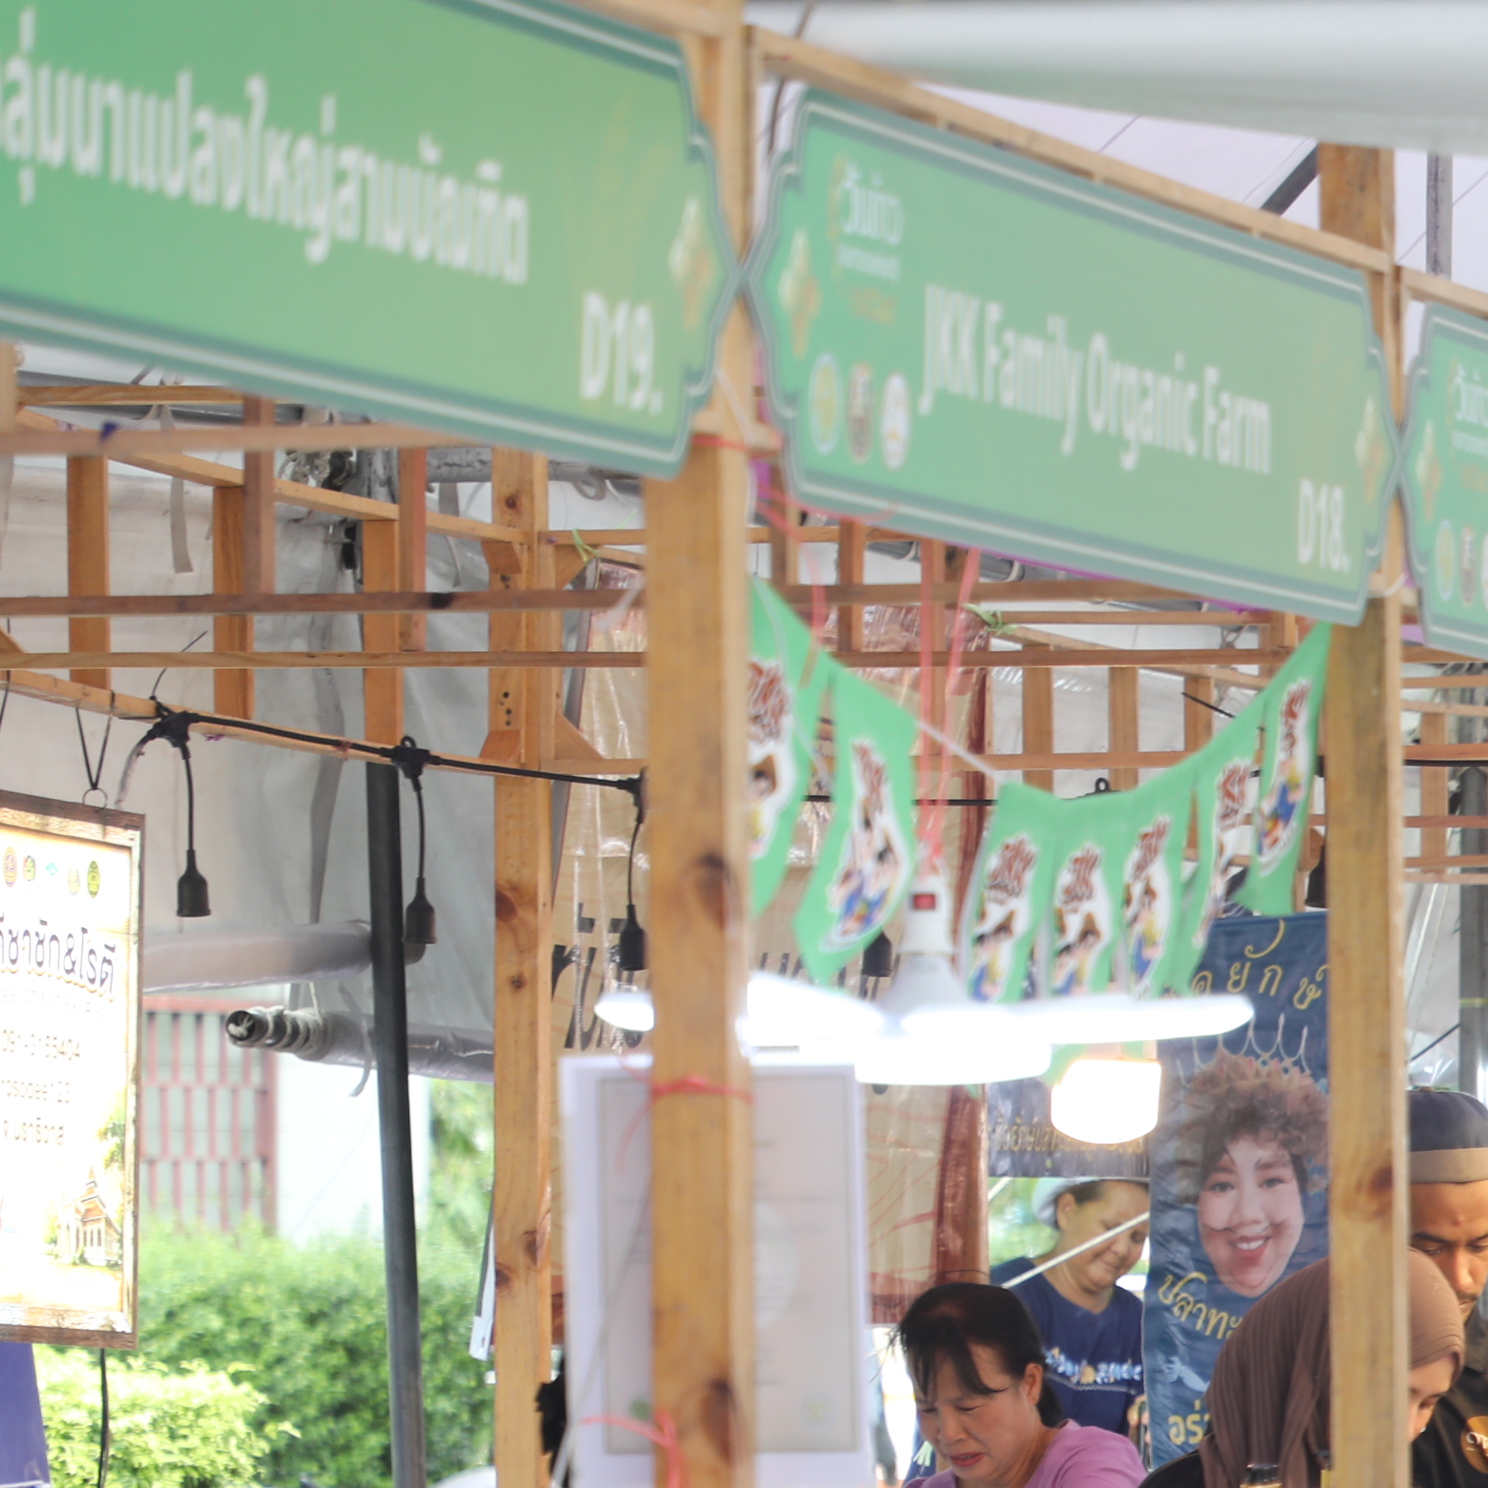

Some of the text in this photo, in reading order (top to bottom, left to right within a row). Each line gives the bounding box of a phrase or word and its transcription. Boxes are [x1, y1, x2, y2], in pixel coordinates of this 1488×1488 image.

[578, 292, 663, 416] D19.
[919, 283, 1272, 474] JKK Family Organic Farm
[1297, 478, 1350, 573] D18.
[1168, 1400, 1211, 1445] อร่
